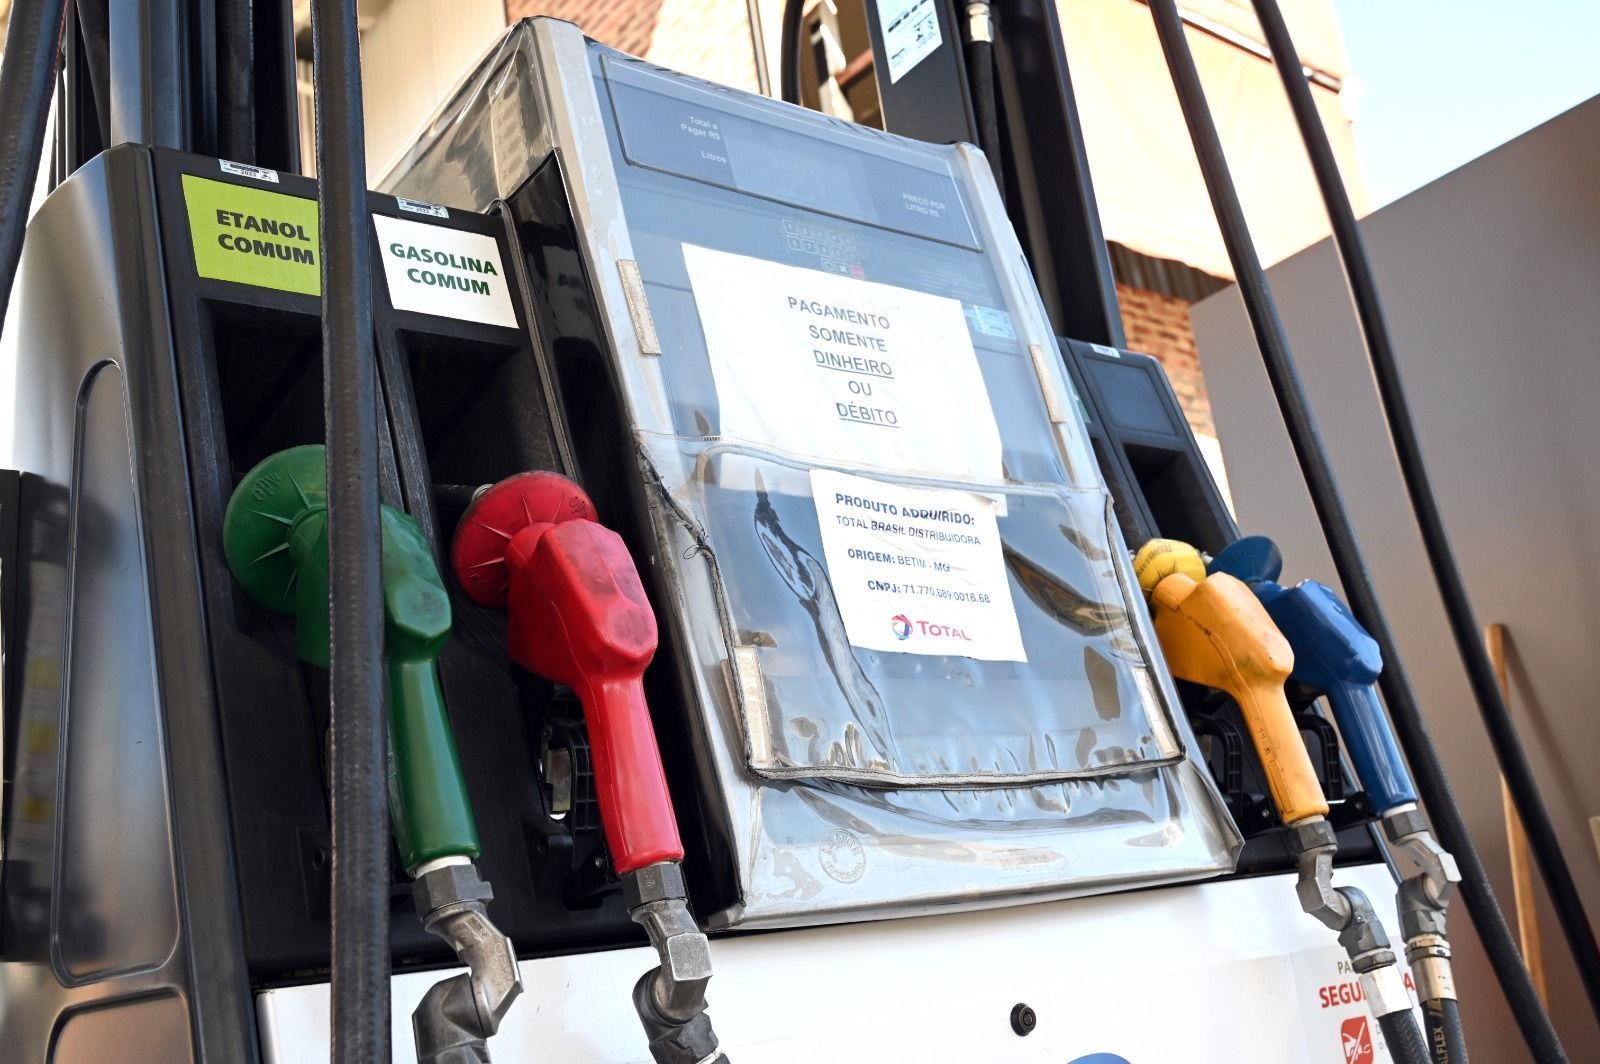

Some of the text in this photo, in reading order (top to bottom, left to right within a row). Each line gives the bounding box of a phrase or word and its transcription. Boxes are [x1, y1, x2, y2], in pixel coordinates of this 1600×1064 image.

[680, 124, 706, 137] Pagar
[688, 116, 710, 128] Total
[700, 150, 727, 164] Litros
[216, 209, 311, 242] ETANOL
[218, 233, 315, 266] COMUM
[389, 242, 498, 276] GASOLINA
[407, 268, 491, 296] COMUM
[787, 296, 890, 330] PAGAMENTO
[808, 325, 888, 353] SOMENTE
[813, 349, 894, 379] DINHEIRO
[848, 380, 873, 397] OU
[835, 400, 899, 427] DÉBITO
[835, 493, 975, 526] PRODUTO ADQUIRIDO:
[835, 515, 981, 545] TOTAL BRASIL DISTRIBUIDORA
[847, 548, 896, 564] ORIGEM:
[897, 554, 927, 569] BETIM
[933, 562, 951, 573] MG
[867, 579, 902, 595] CNPJ:
[915, 620, 972, 641] TOTAL
